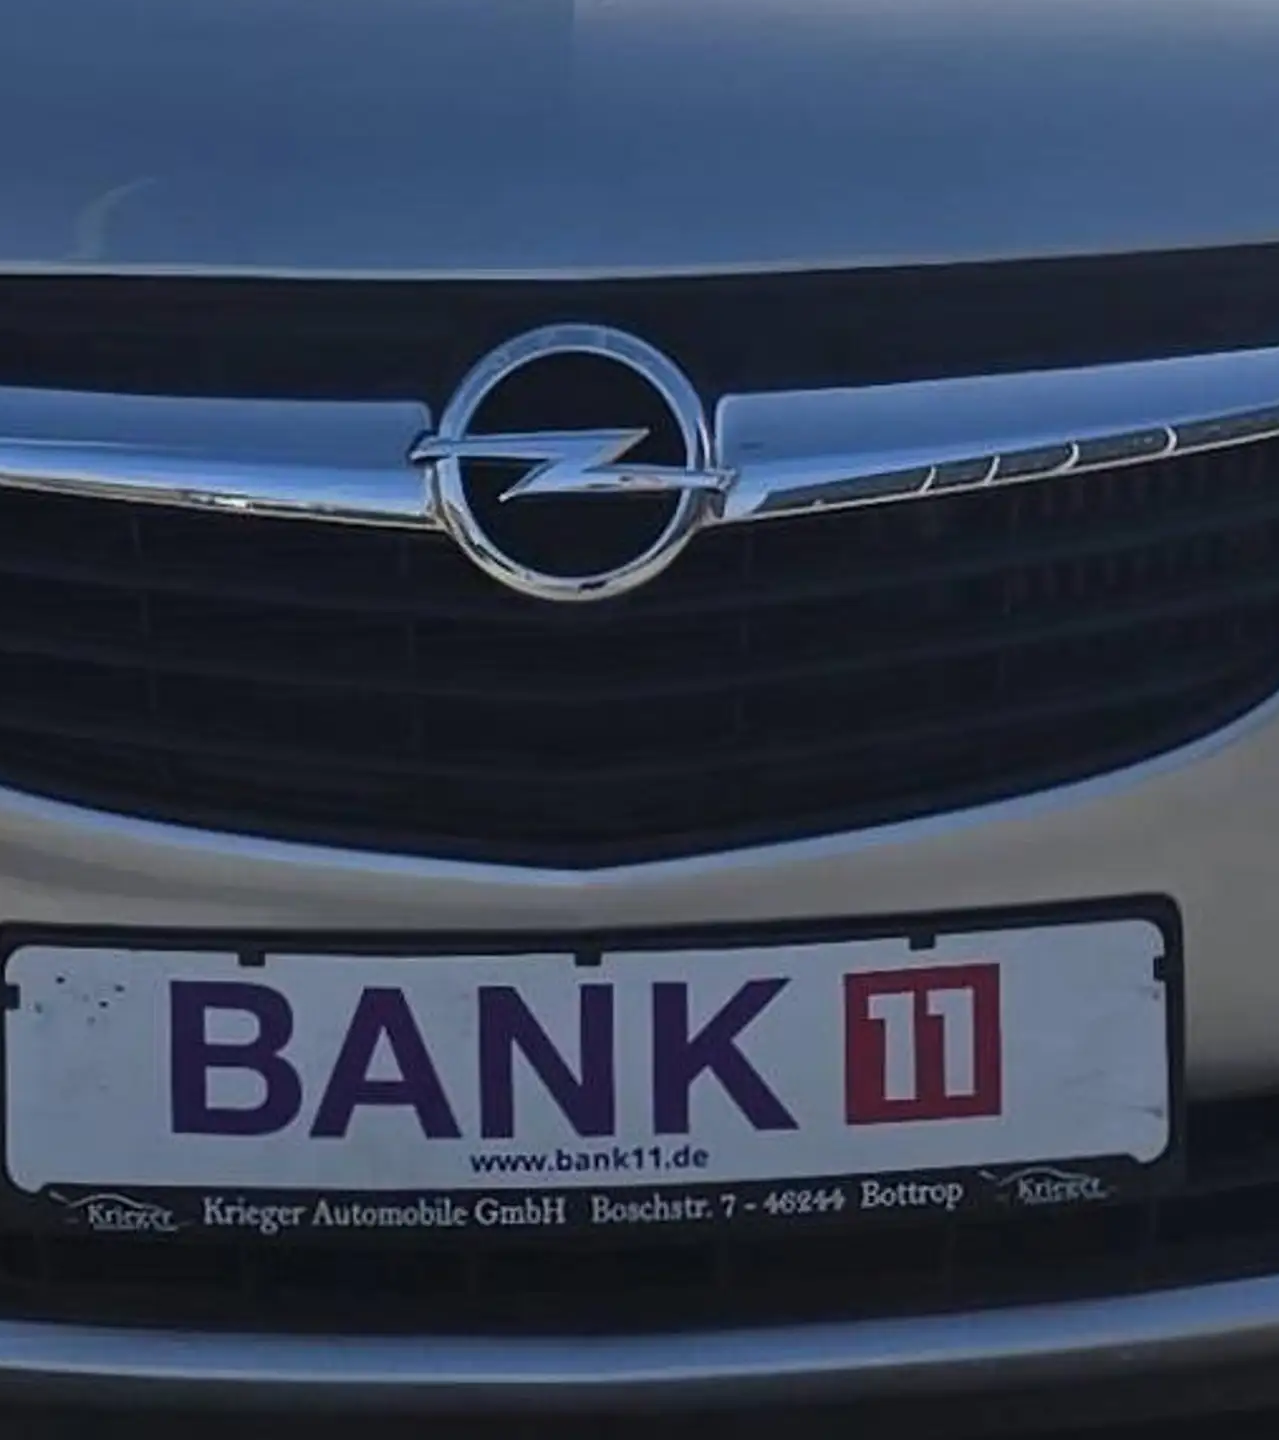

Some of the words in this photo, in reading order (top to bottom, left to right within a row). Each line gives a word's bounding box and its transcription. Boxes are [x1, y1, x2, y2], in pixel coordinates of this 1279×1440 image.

[170, 977, 800, 1139] BANK
[867, 987, 976, 1101] 11
[470, 1144, 710, 1173] www.bank11.de
[203, 1197, 305, 1234] Krieger
[311, 1197, 469, 1227] Automobile
[474, 1196, 566, 1226] GmbH
[591, 1194, 714, 1225] Boschstr.
[719, 1191, 737, 1219] 7
[762, 1186, 847, 1216] 46244
[860, 1179, 964, 1213] Bottrop
